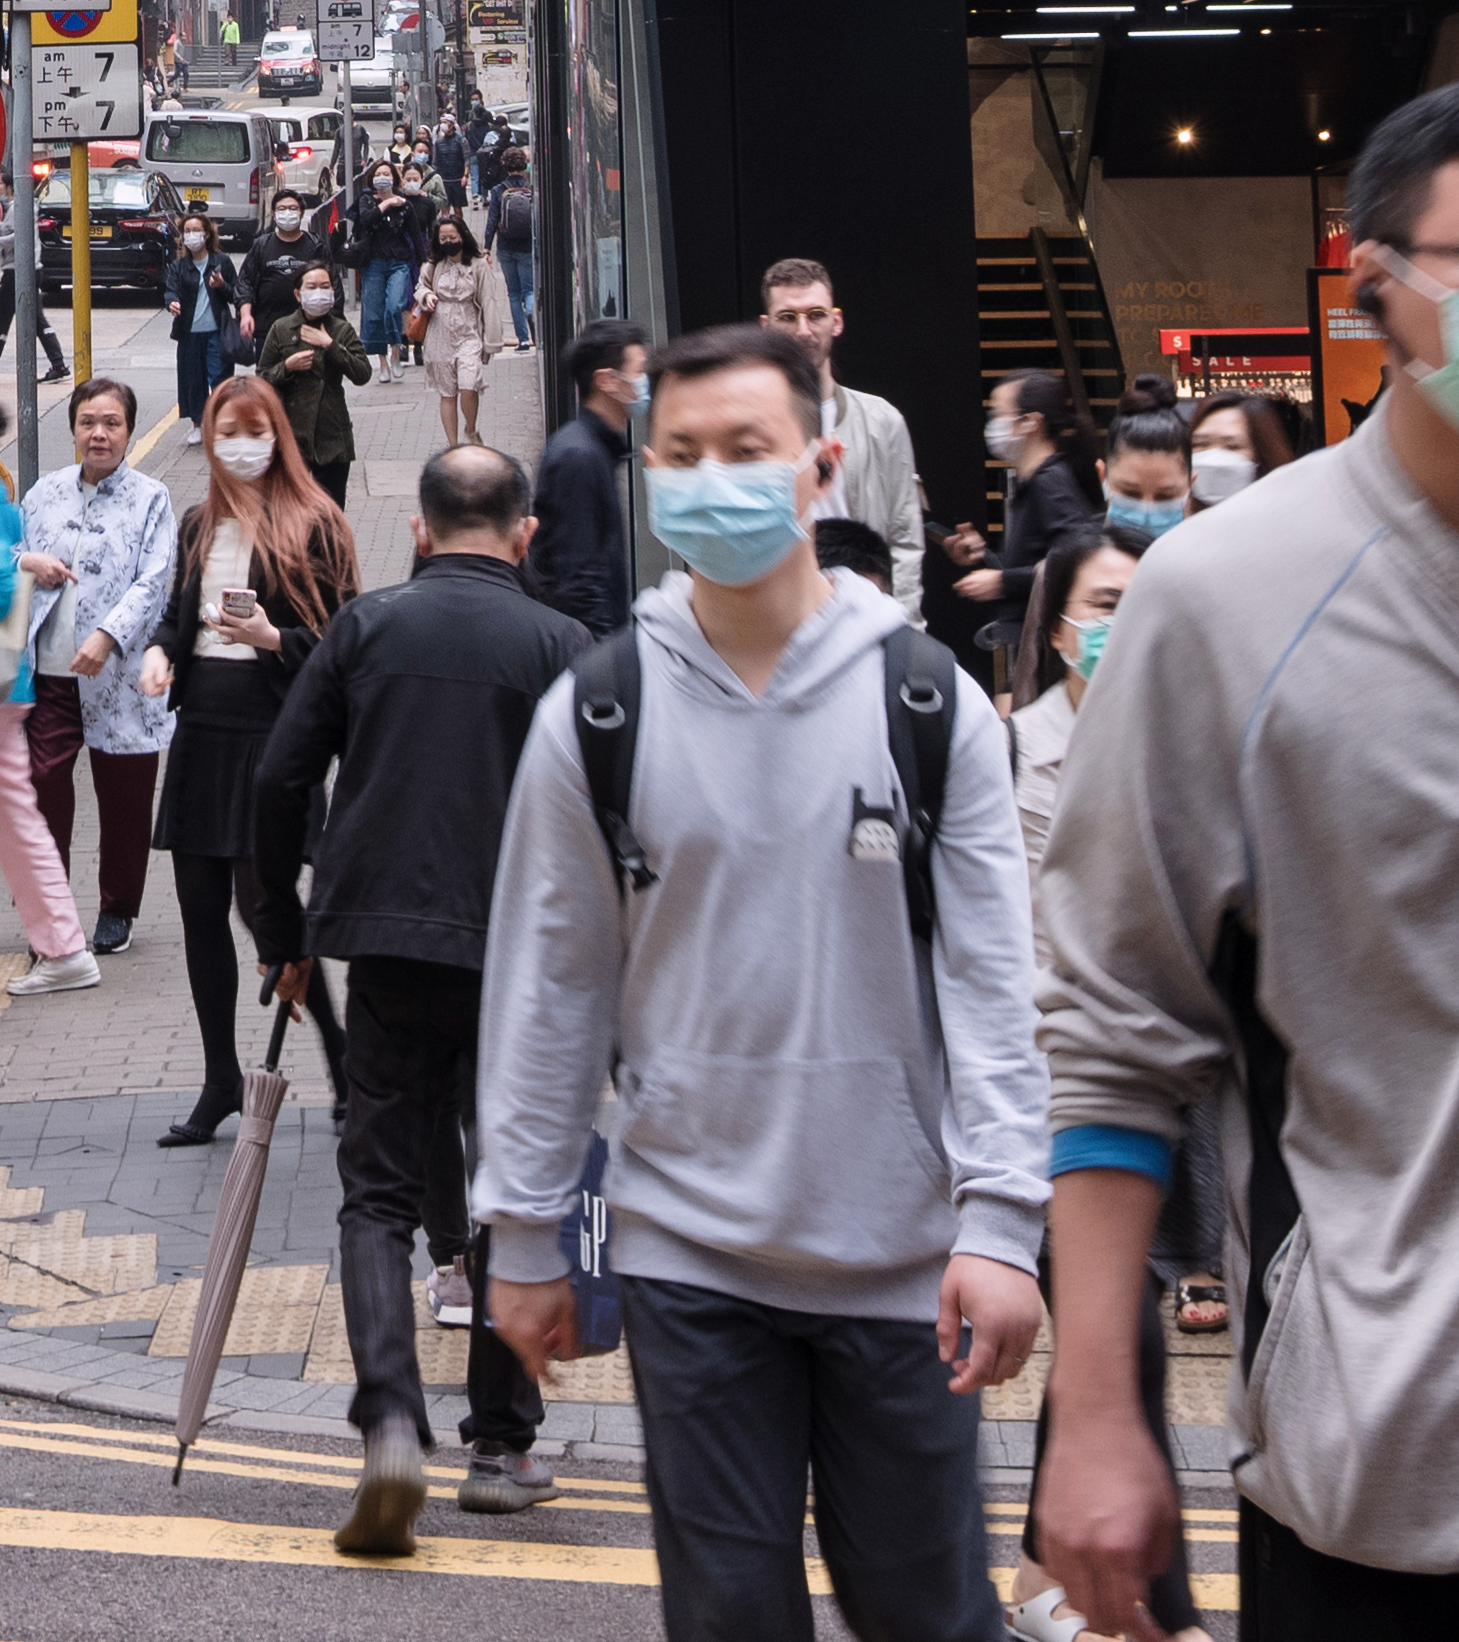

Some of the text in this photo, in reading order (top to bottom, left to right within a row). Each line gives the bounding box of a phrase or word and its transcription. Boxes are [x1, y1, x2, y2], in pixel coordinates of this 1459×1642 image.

[352, 24, 363, 37] 7
[43, 51, 67, 64] am
[353, 44, 371, 57] 12
[36, 65, 74, 85] 上午
[94, 52, 116, 82] 7
[43, 99, 67, 115] pm
[94, 100, 116, 131] 7
[37, 115, 74, 133] 下午
[1192, 356, 1252, 368] SALE
